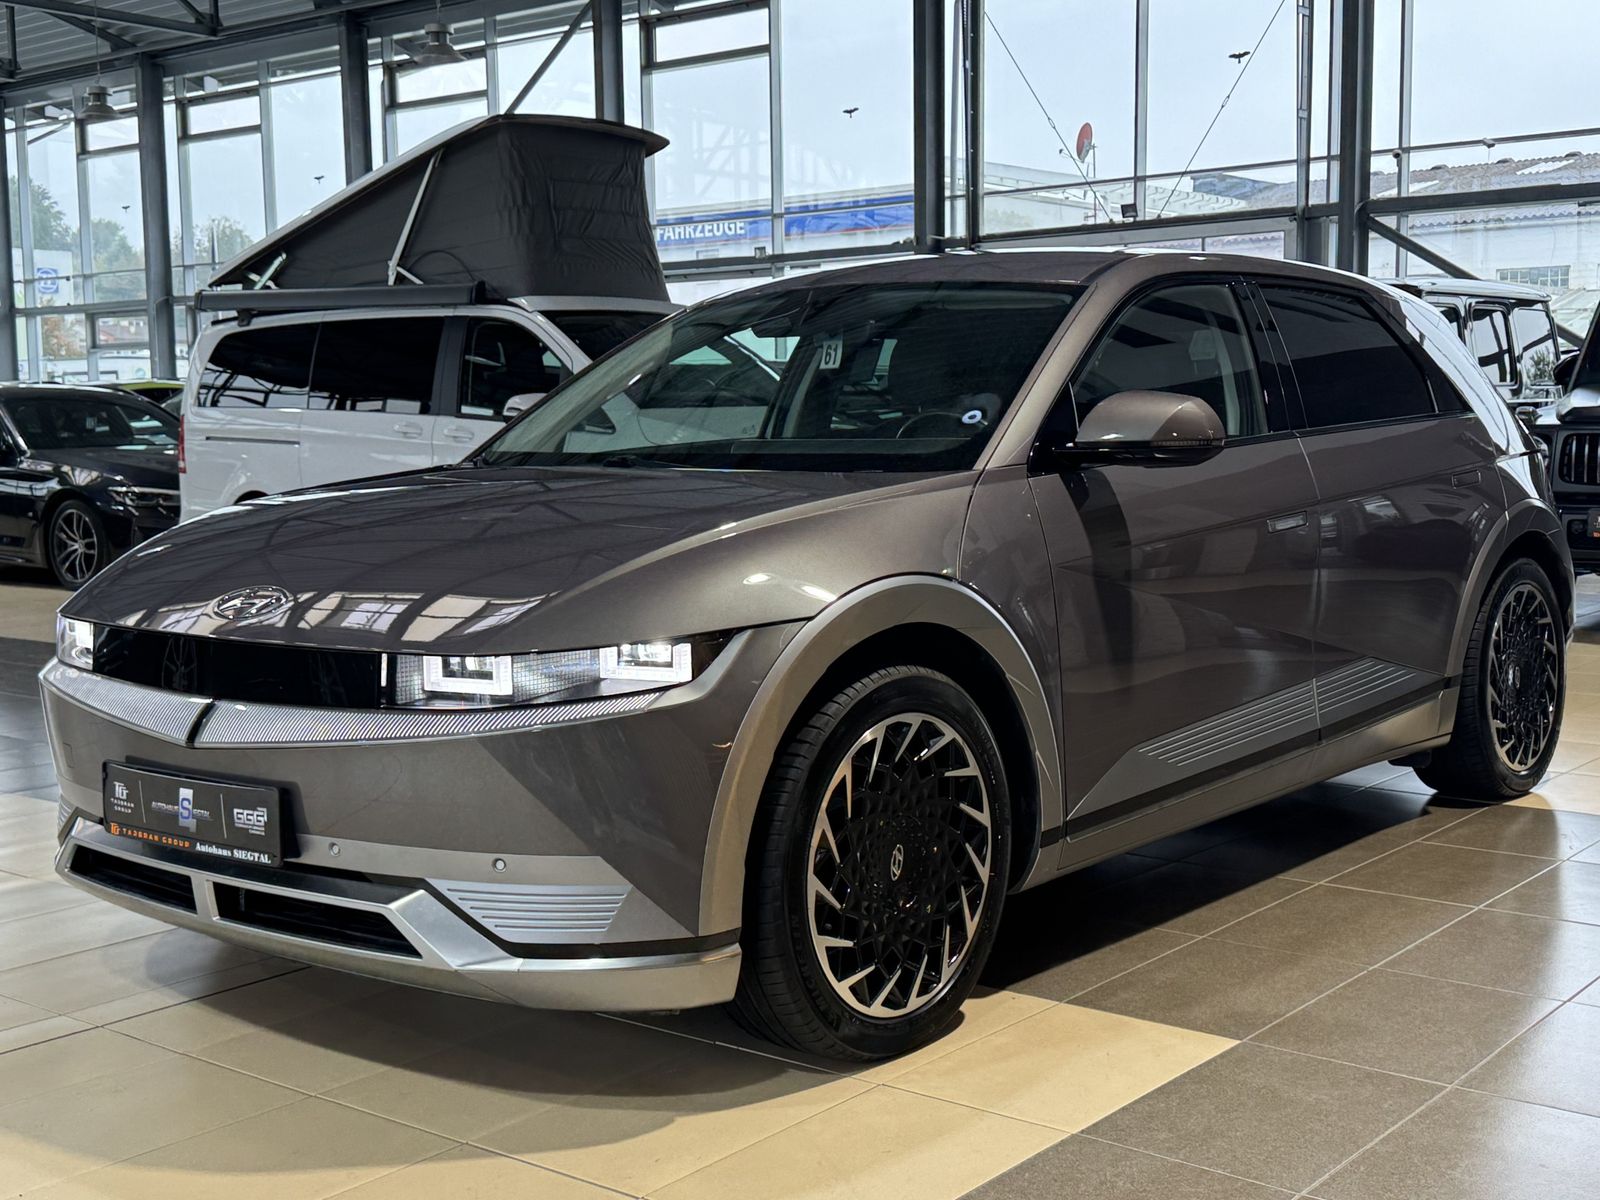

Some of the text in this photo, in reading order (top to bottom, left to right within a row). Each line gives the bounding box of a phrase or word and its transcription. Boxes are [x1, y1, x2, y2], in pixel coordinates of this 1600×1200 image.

[656, 221, 746, 241] FAHRZEUGE
[824, 344, 838, 365] 61
[195, 842, 272, 864] Autohaus SIEGTAL
